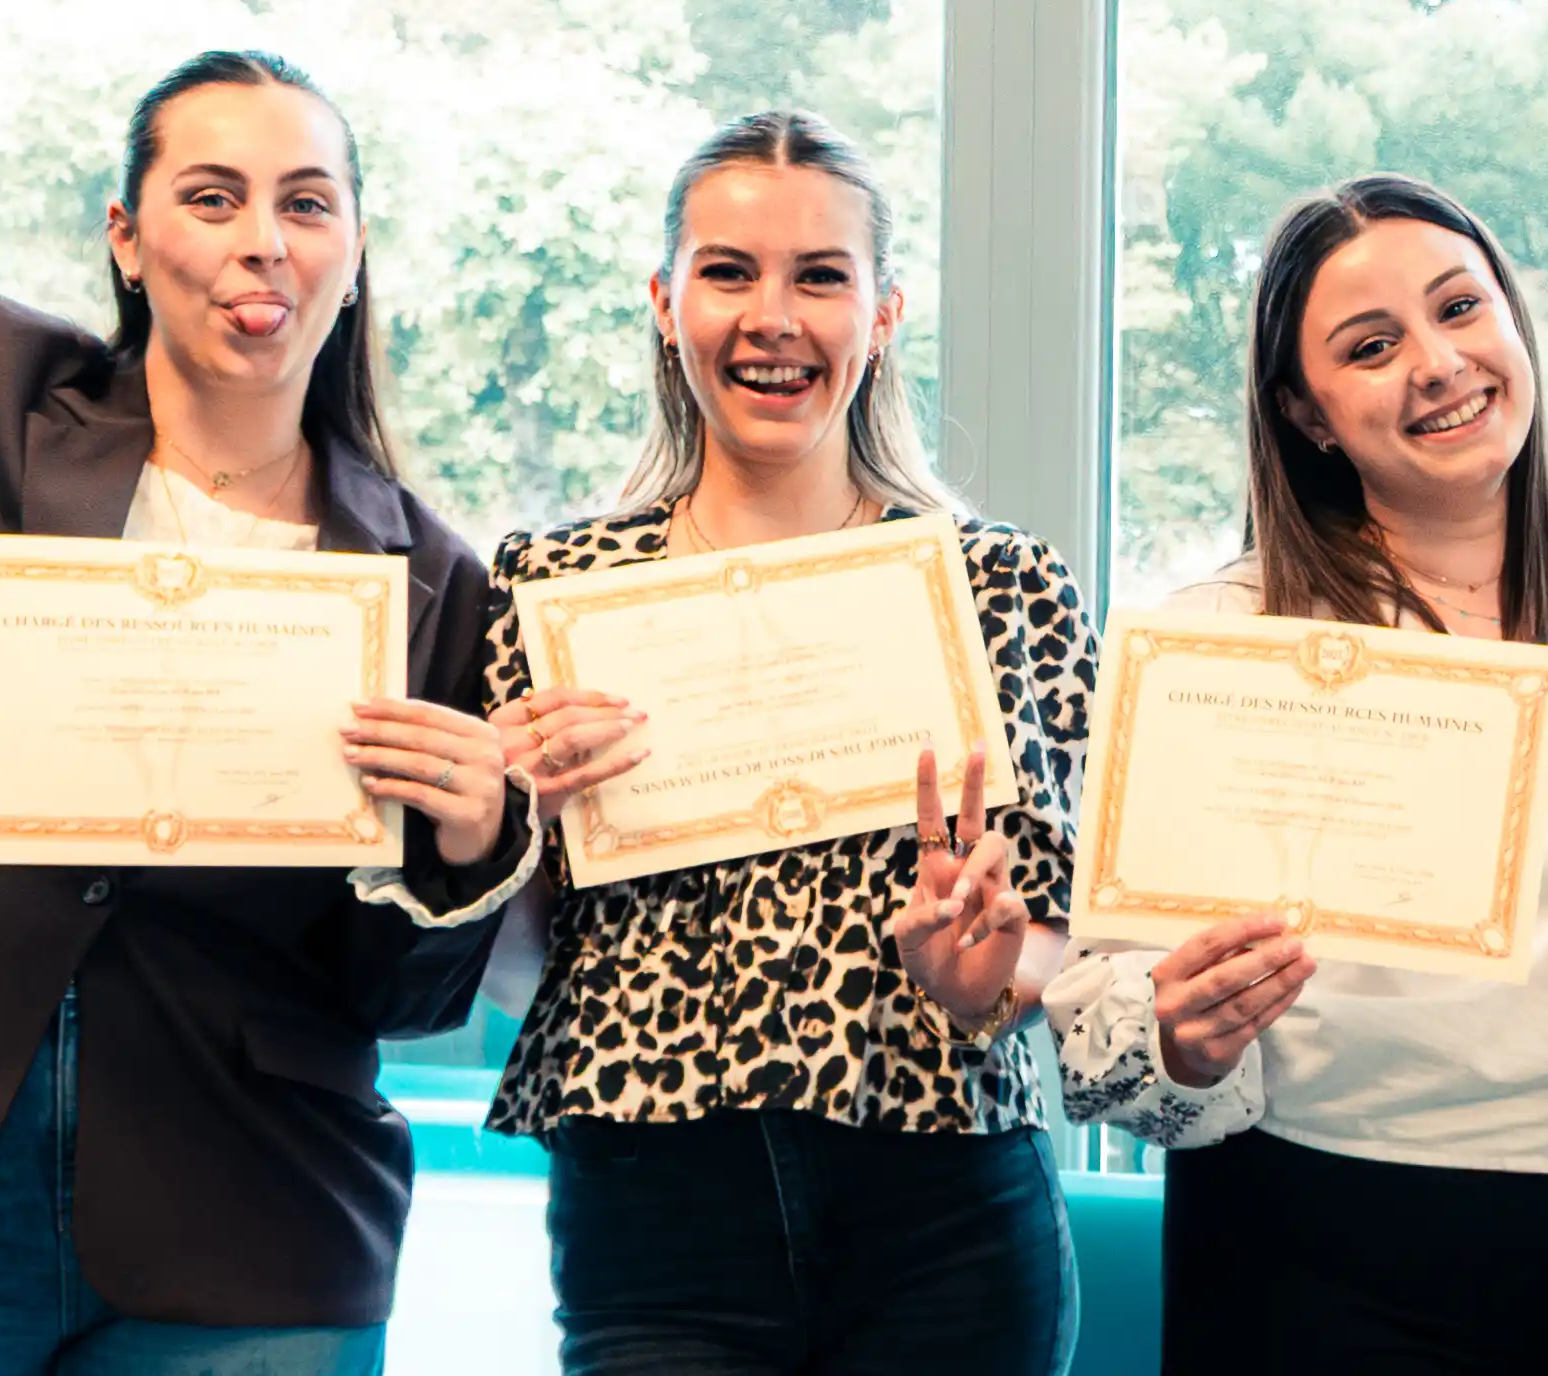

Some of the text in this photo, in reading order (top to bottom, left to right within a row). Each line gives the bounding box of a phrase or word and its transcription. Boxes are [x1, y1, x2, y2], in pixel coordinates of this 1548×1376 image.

[80, 617, 116, 630] DES
[120, 618, 233, 634] RESSOURCES
[238, 620, 332, 638] HUMAINES
[1240, 695, 1274, 711] DES
[1278, 699, 1387, 722] RESSOURCES
[1392, 711, 1484, 734] HUMAINES
